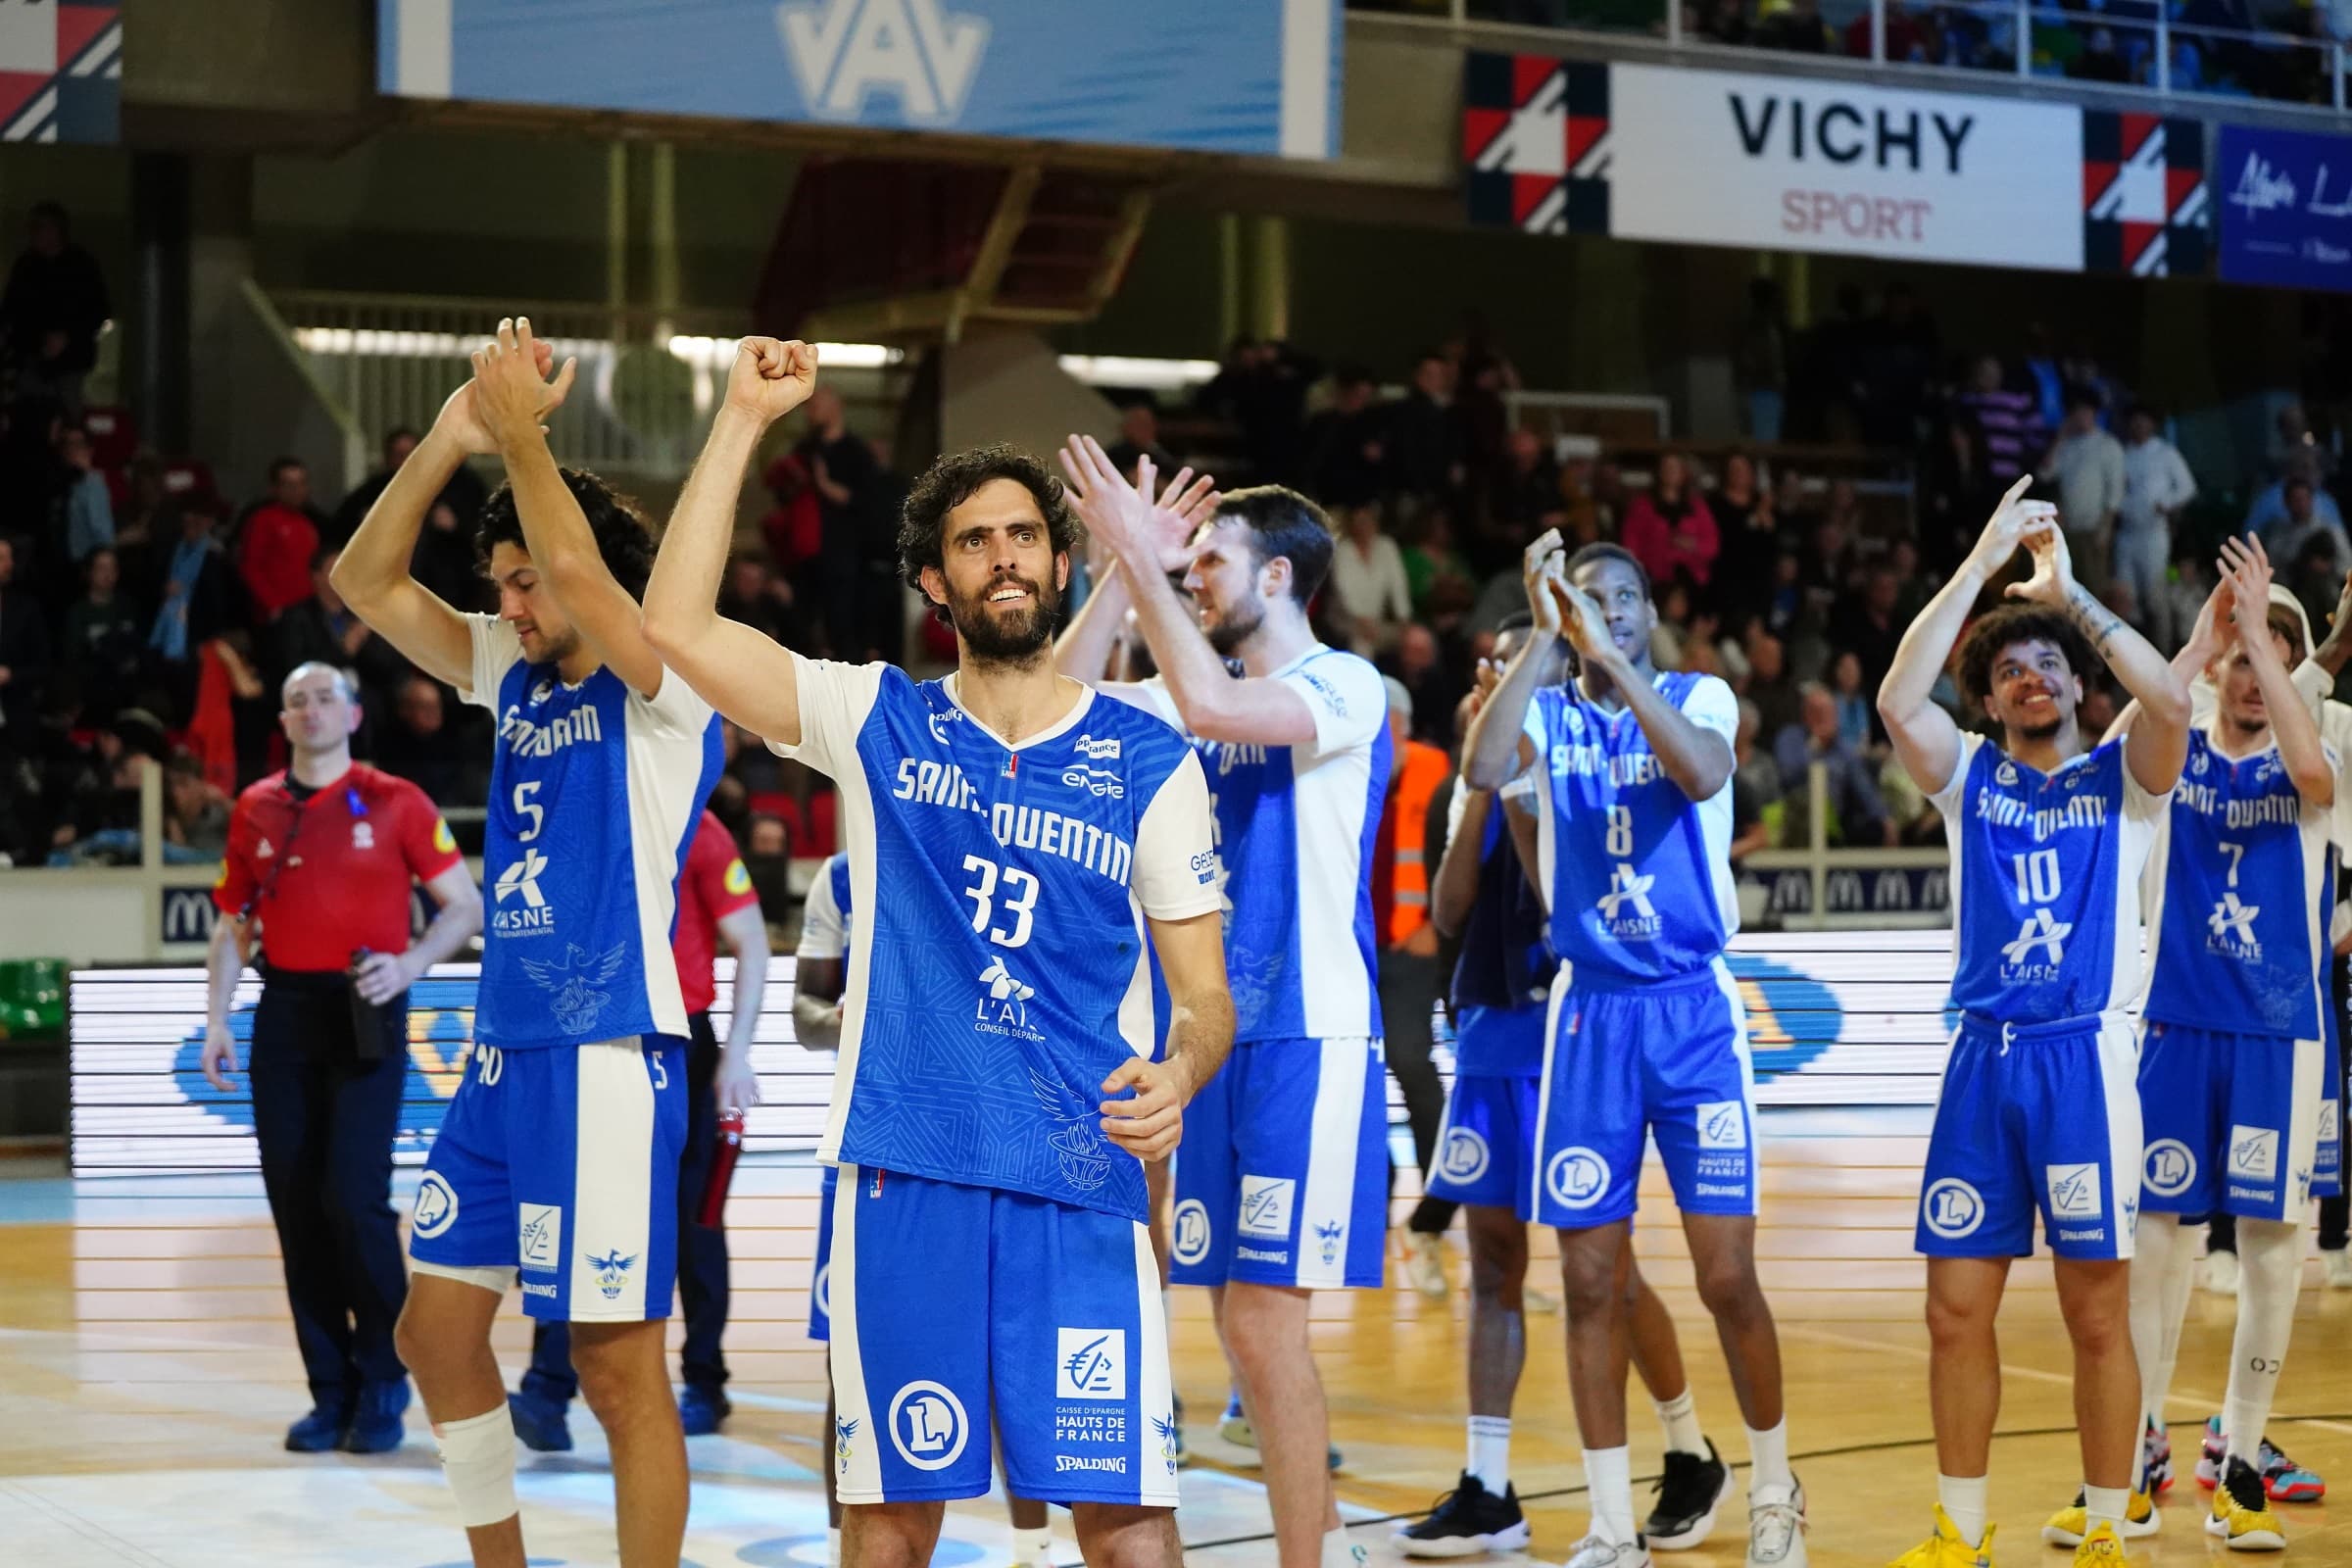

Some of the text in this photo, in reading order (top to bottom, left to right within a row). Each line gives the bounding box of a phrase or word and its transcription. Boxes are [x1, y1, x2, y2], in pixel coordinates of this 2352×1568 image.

[1728, 92, 1974, 173] VICHY
[1782, 188, 1935, 241] SPORT
[513, 781, 544, 843] 5
[1605, 804, 1633, 857] 8
[2013, 848, 2061, 905] 10
[2219, 841, 2244, 888] 7
[961, 854, 1040, 949] 33
[974, 1022, 1010, 1036] CONSEIL
[652, 1051, 668, 1090] 5
[1055, 1416, 1125, 1429] HAUTS DE
[1055, 1429, 1126, 1443] FRANCE
[1055, 1454, 1126, 1474] SPALDING
